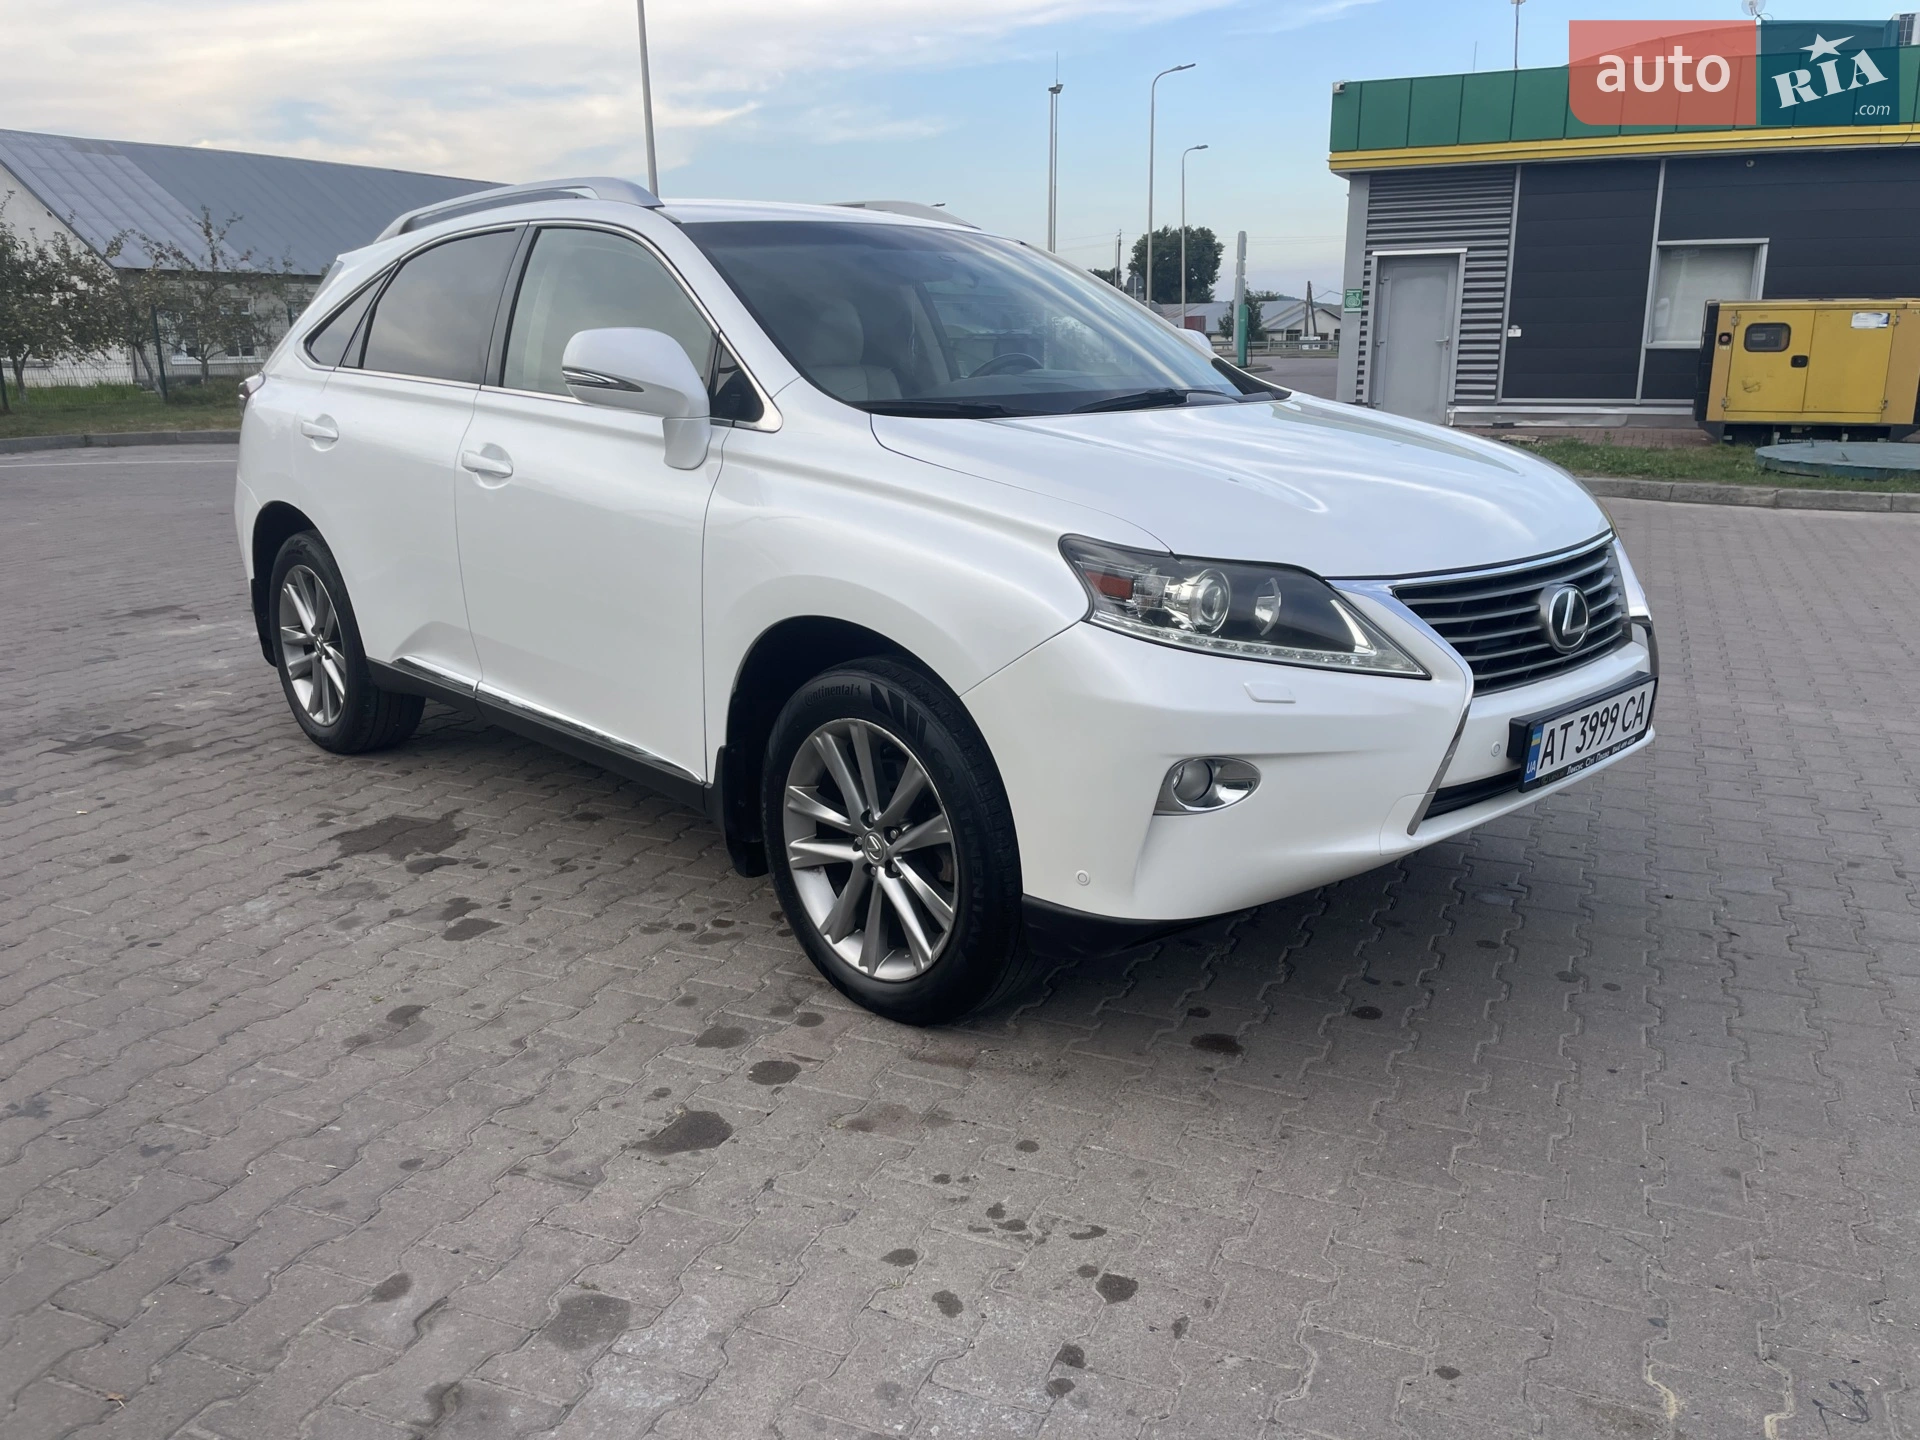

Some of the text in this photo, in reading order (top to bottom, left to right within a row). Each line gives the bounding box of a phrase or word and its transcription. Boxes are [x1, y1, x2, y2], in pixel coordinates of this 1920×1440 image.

[804, 684, 855, 706] Continental
[1539, 691, 1646, 770] AT 3999 CA
[1526, 760, 1537, 774] UA
